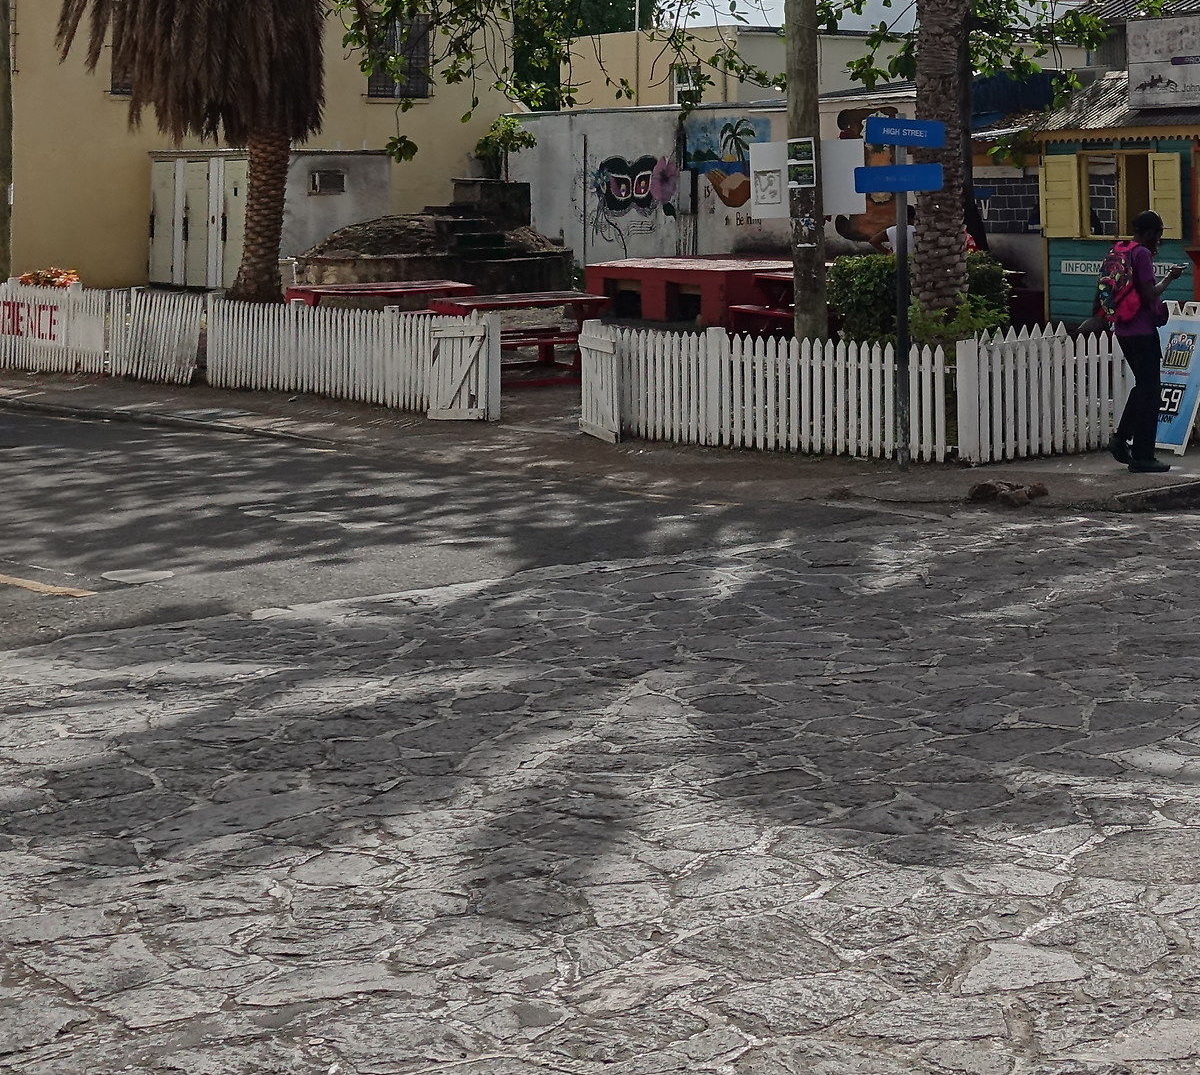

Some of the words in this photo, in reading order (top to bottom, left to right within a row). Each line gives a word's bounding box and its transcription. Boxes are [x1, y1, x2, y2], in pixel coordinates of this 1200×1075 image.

[882, 128, 900, 136] HIGH
[902, 129, 928, 138] STREET
[1165, 349, 1190, 366] LOTTO
[1159, 388, 1183, 412] 59
